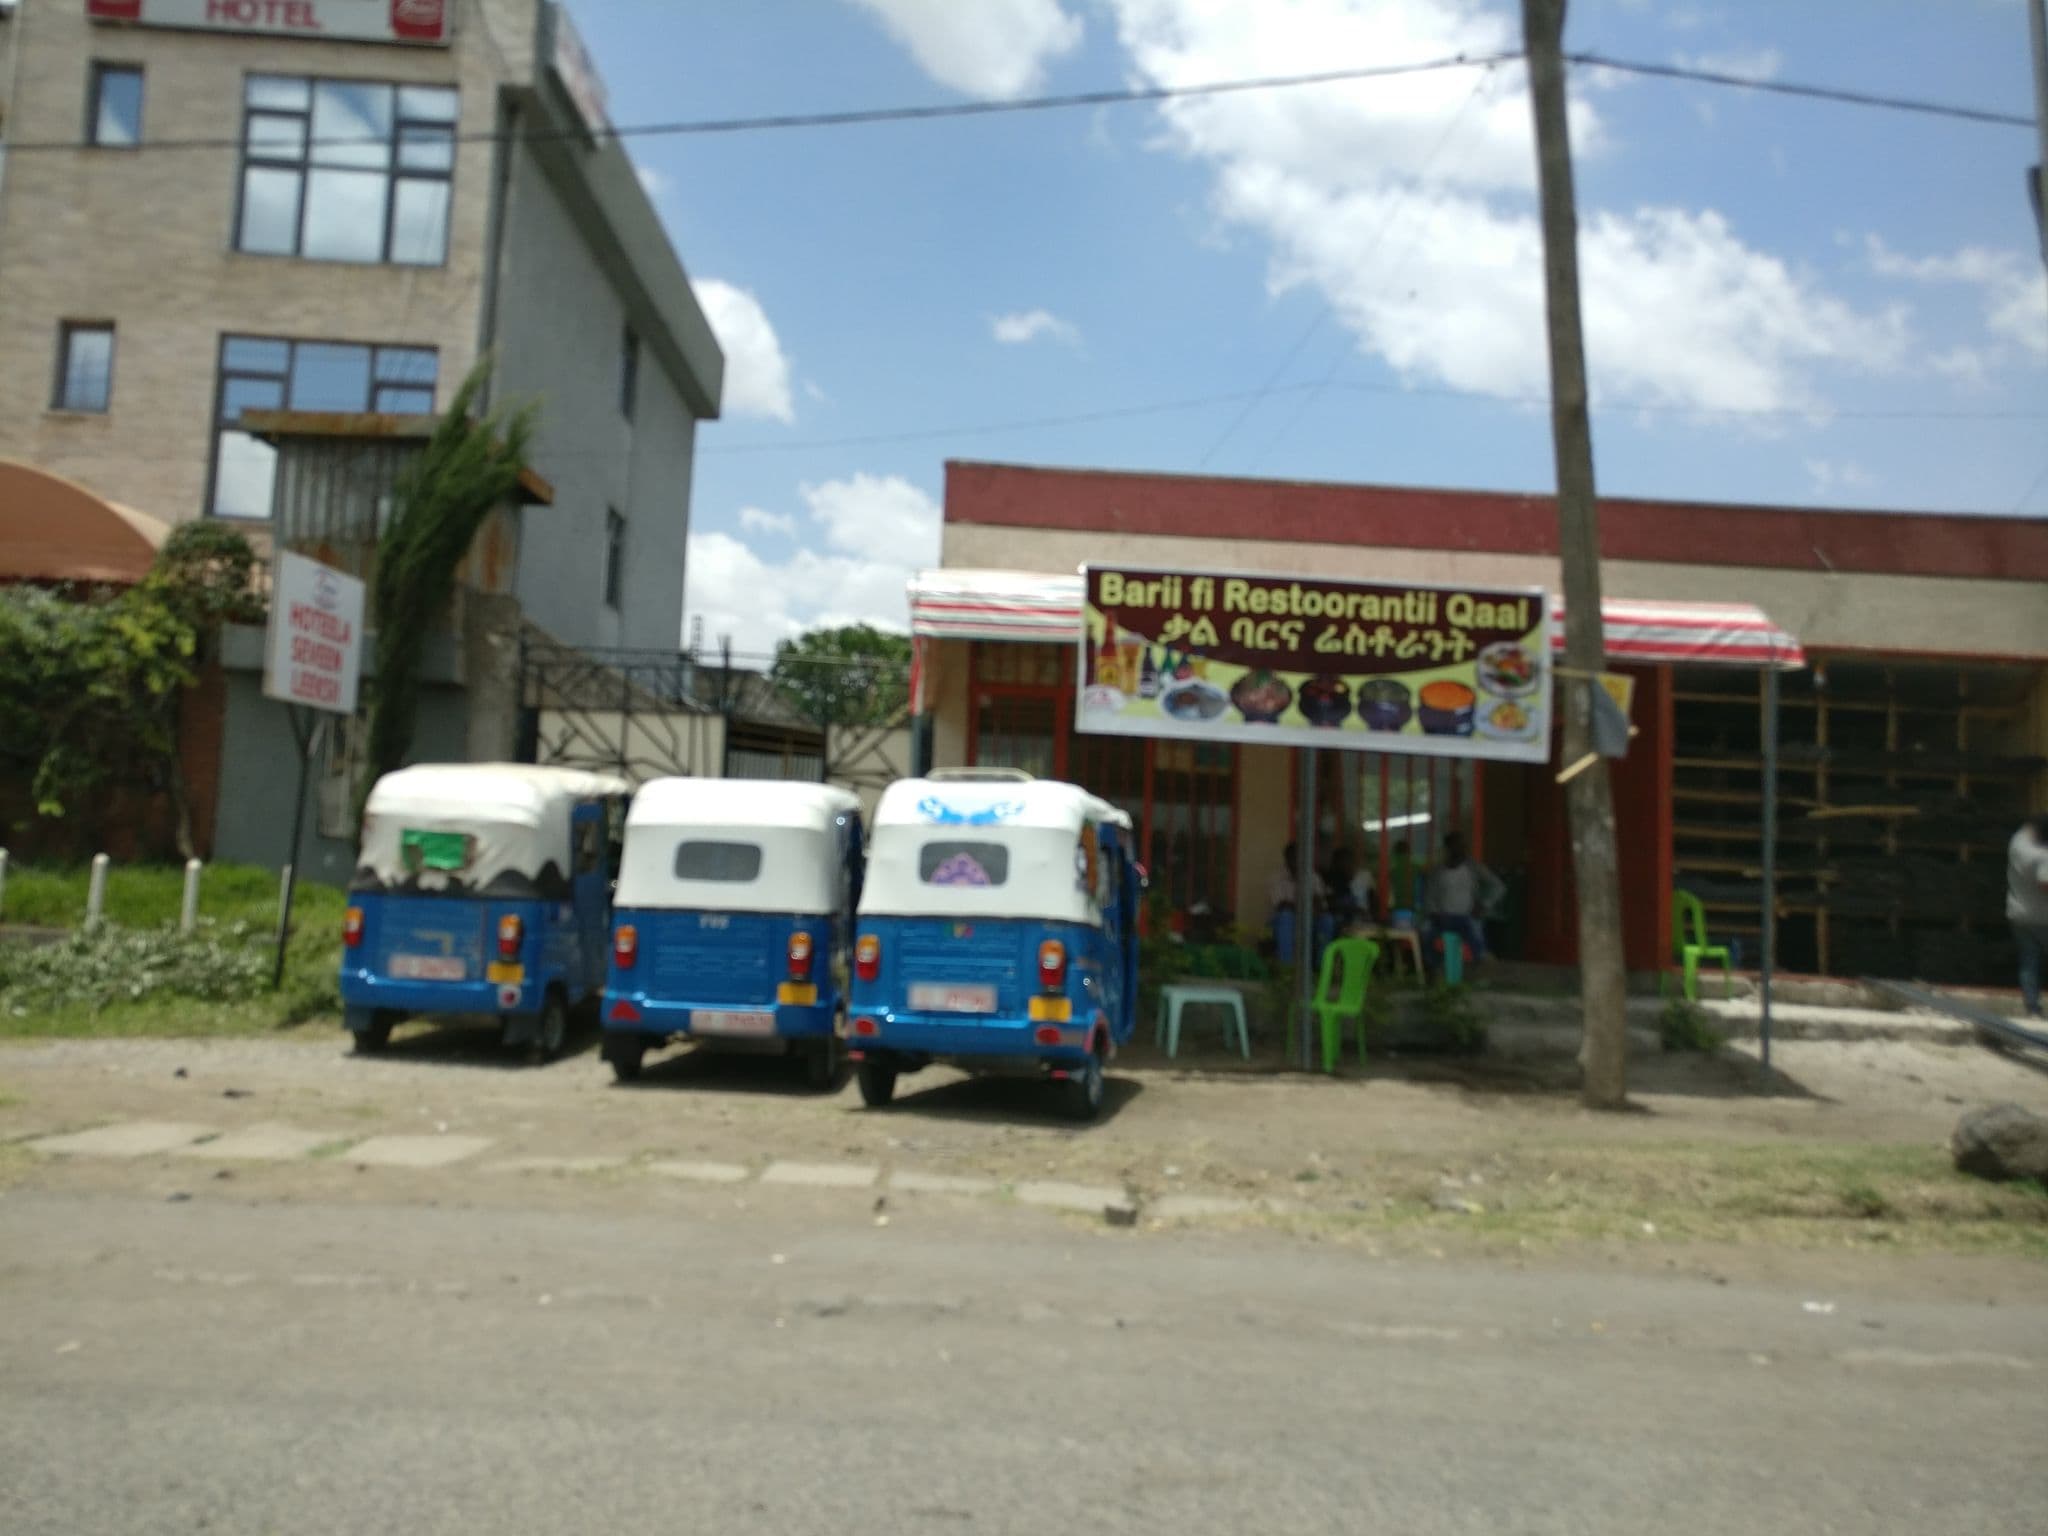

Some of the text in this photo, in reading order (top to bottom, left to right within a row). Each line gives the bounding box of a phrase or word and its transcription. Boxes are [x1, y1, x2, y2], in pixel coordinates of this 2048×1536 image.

[205, 0, 323, 28] HOTEL
[1100, 571, 1529, 630] Barii fi Restoorantii Qaal
